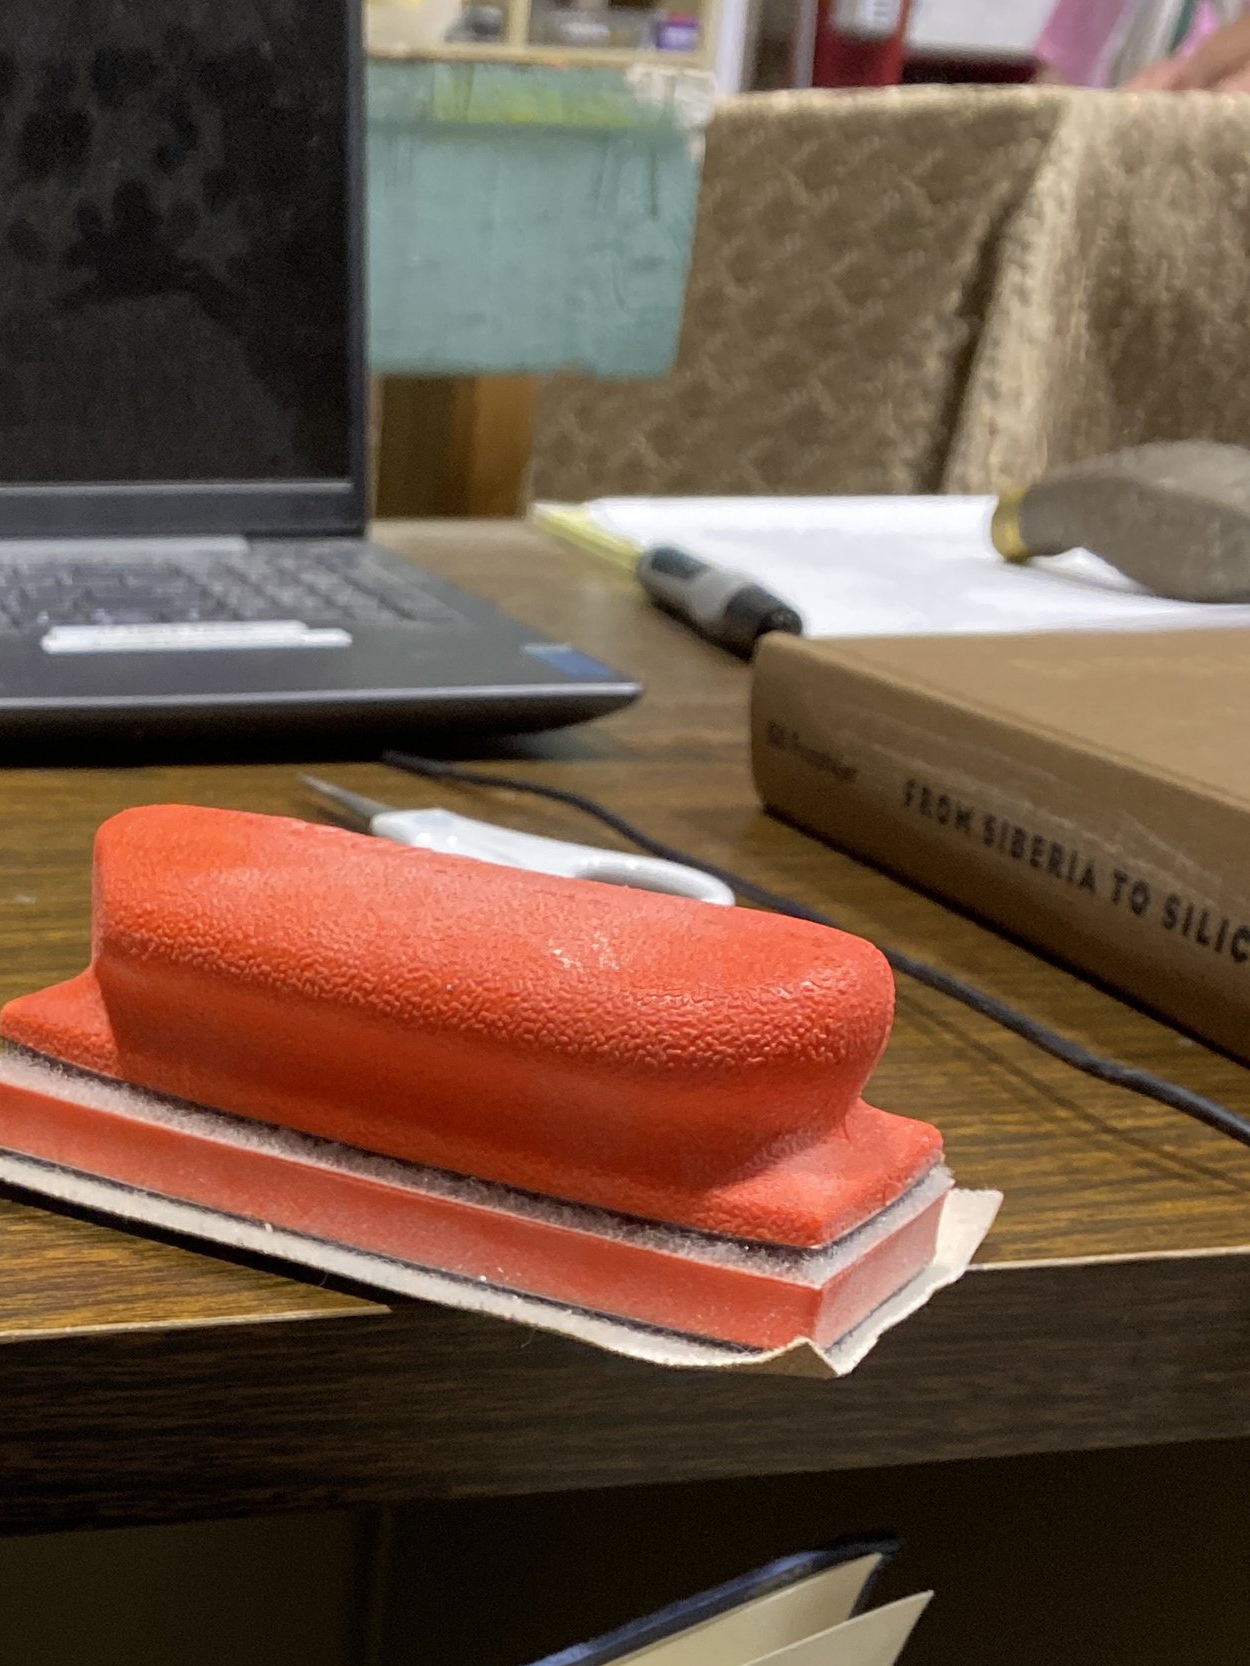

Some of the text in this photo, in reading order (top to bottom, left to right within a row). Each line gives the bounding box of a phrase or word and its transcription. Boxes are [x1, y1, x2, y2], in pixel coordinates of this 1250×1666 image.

[903, 778, 1250, 962] FROM SIBERIA TO SILIC
